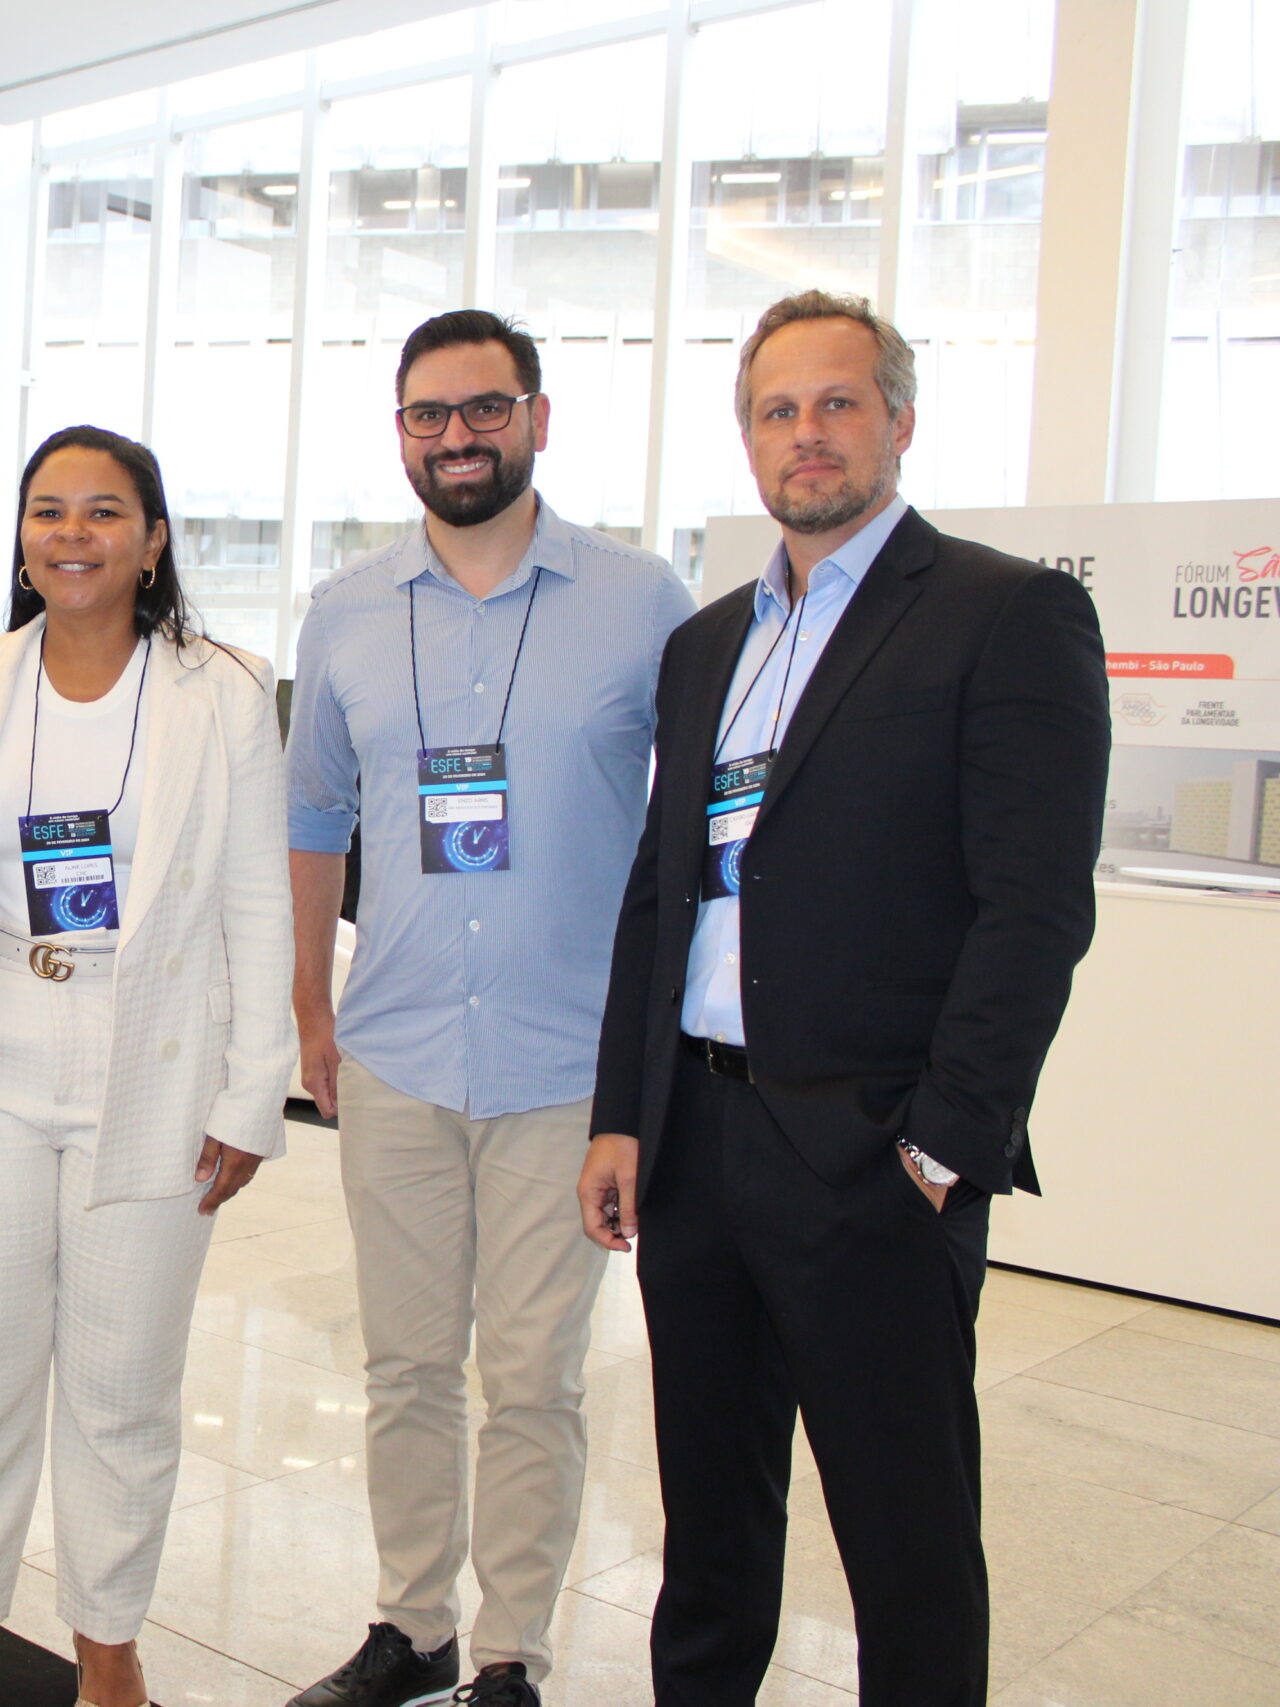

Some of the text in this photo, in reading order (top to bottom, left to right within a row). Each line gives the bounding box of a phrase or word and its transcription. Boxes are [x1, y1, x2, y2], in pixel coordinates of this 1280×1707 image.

[1175, 561, 1230, 583] FÓRUM
[1173, 586, 1280, 618] LONGE
[1149, 660, 1169, 671] São
[1172, 661, 1205, 671] Paulo
[1198, 701, 1224, 709] FRENTE
[1186, 709, 1235, 718] PARLAMENTAR
[1192, 717, 1239, 727] LONGEVIDADE
[431, 758, 461, 774] ESFE
[714, 770, 740, 791] ESFE
[33, 824, 64, 840] ESFE
[60, 849, 73, 857] VIP
